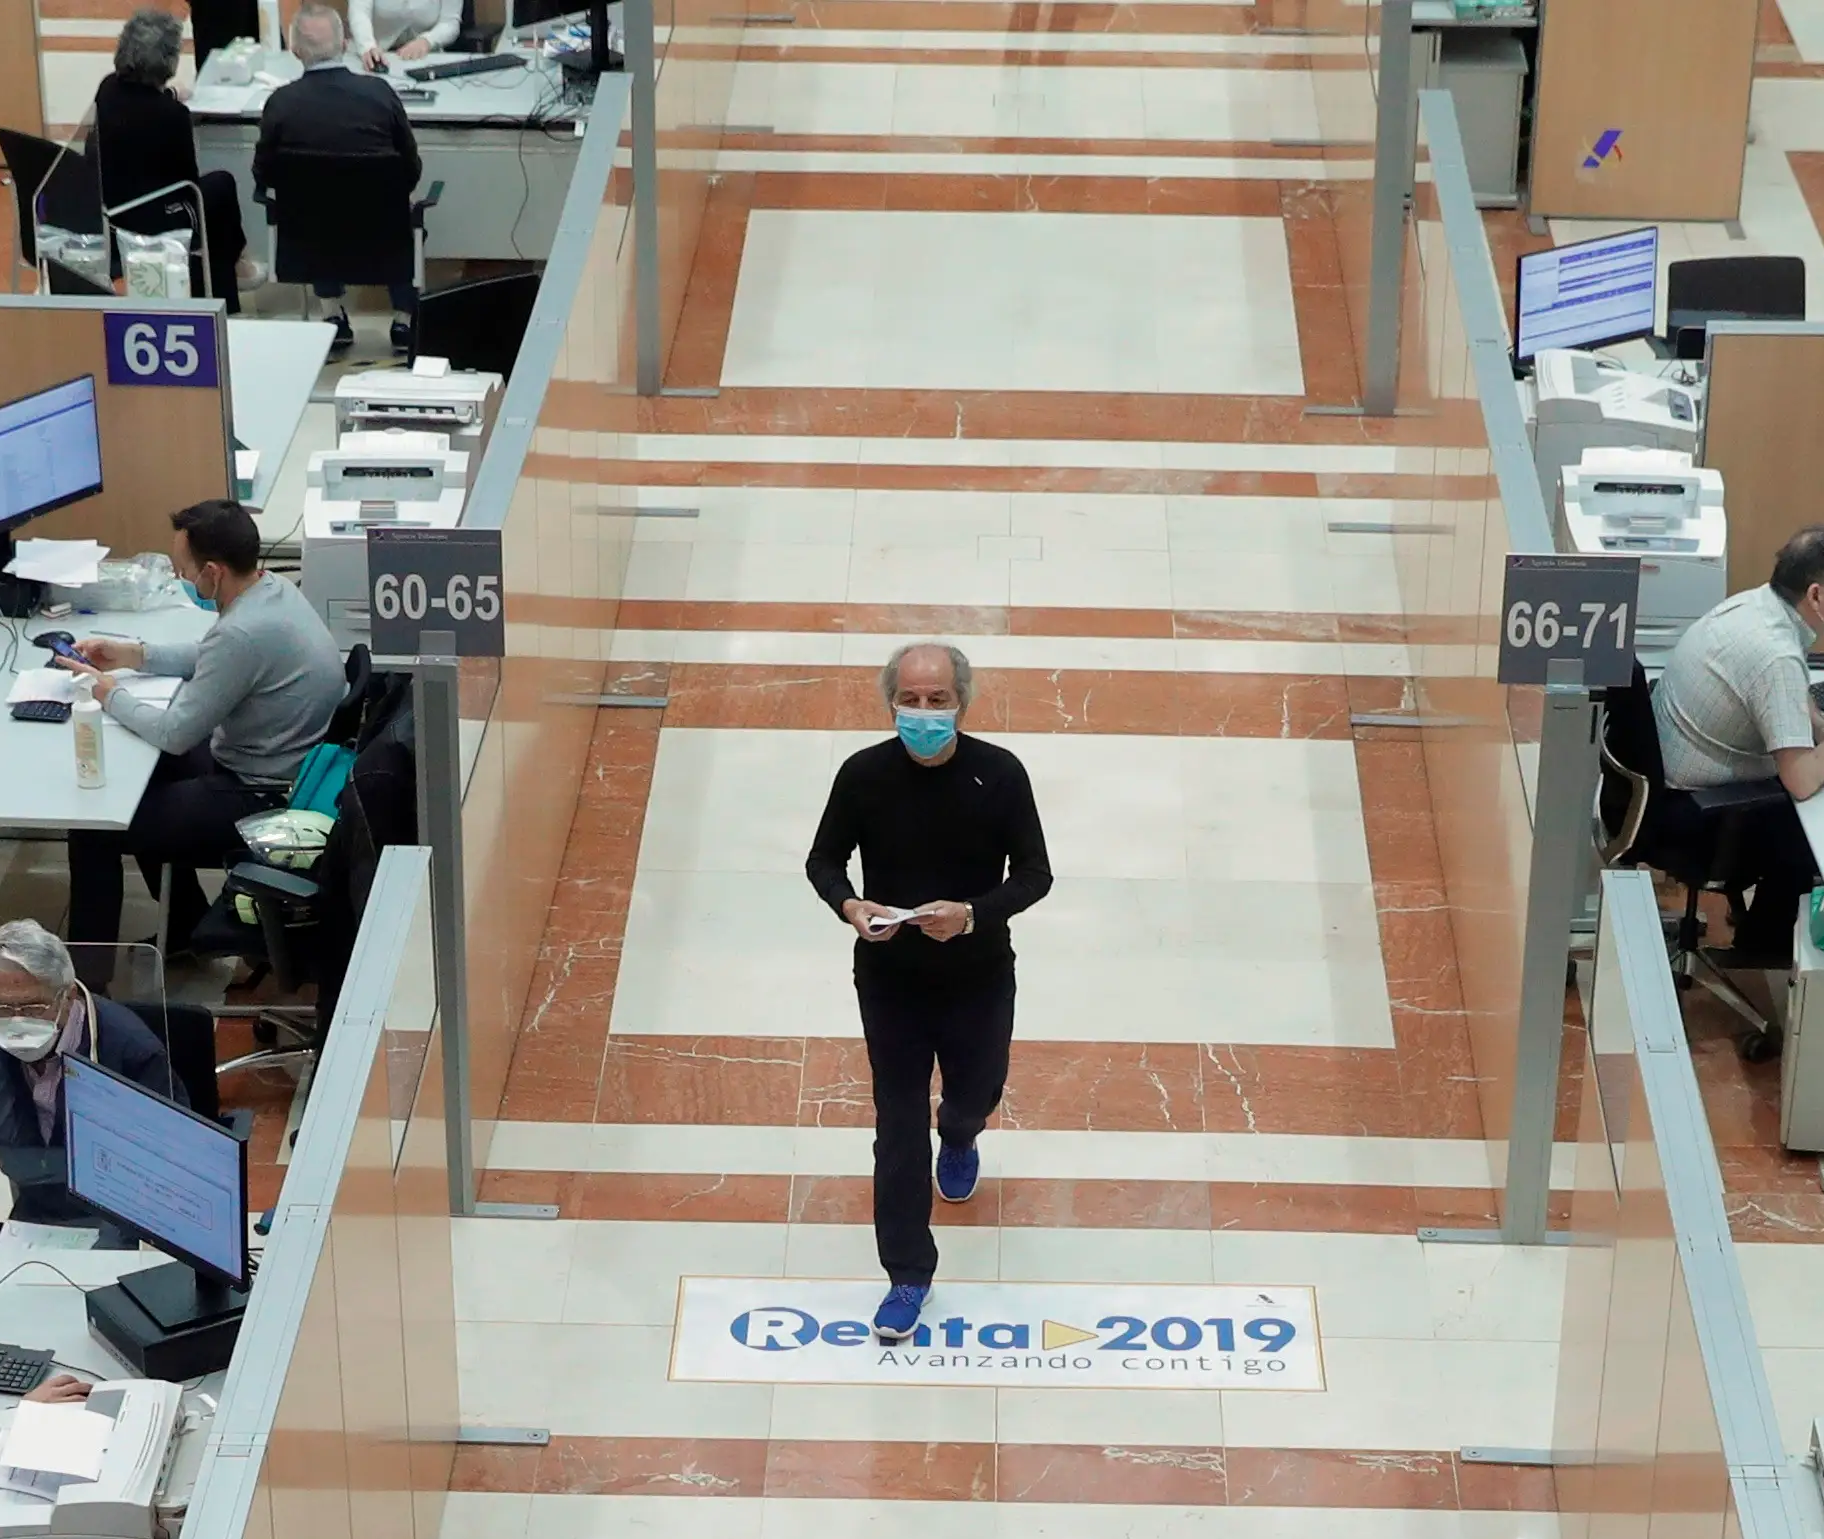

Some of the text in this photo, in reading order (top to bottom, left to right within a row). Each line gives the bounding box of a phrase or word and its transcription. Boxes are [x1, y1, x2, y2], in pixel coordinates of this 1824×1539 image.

[124, 323, 198, 376] 65
[375, 573, 500, 620] 60-65
[1507, 601, 1628, 649] 66-71
[1096, 1315, 1296, 1352] 2019
[877, 1350, 1286, 1375] Avanzando contigo
